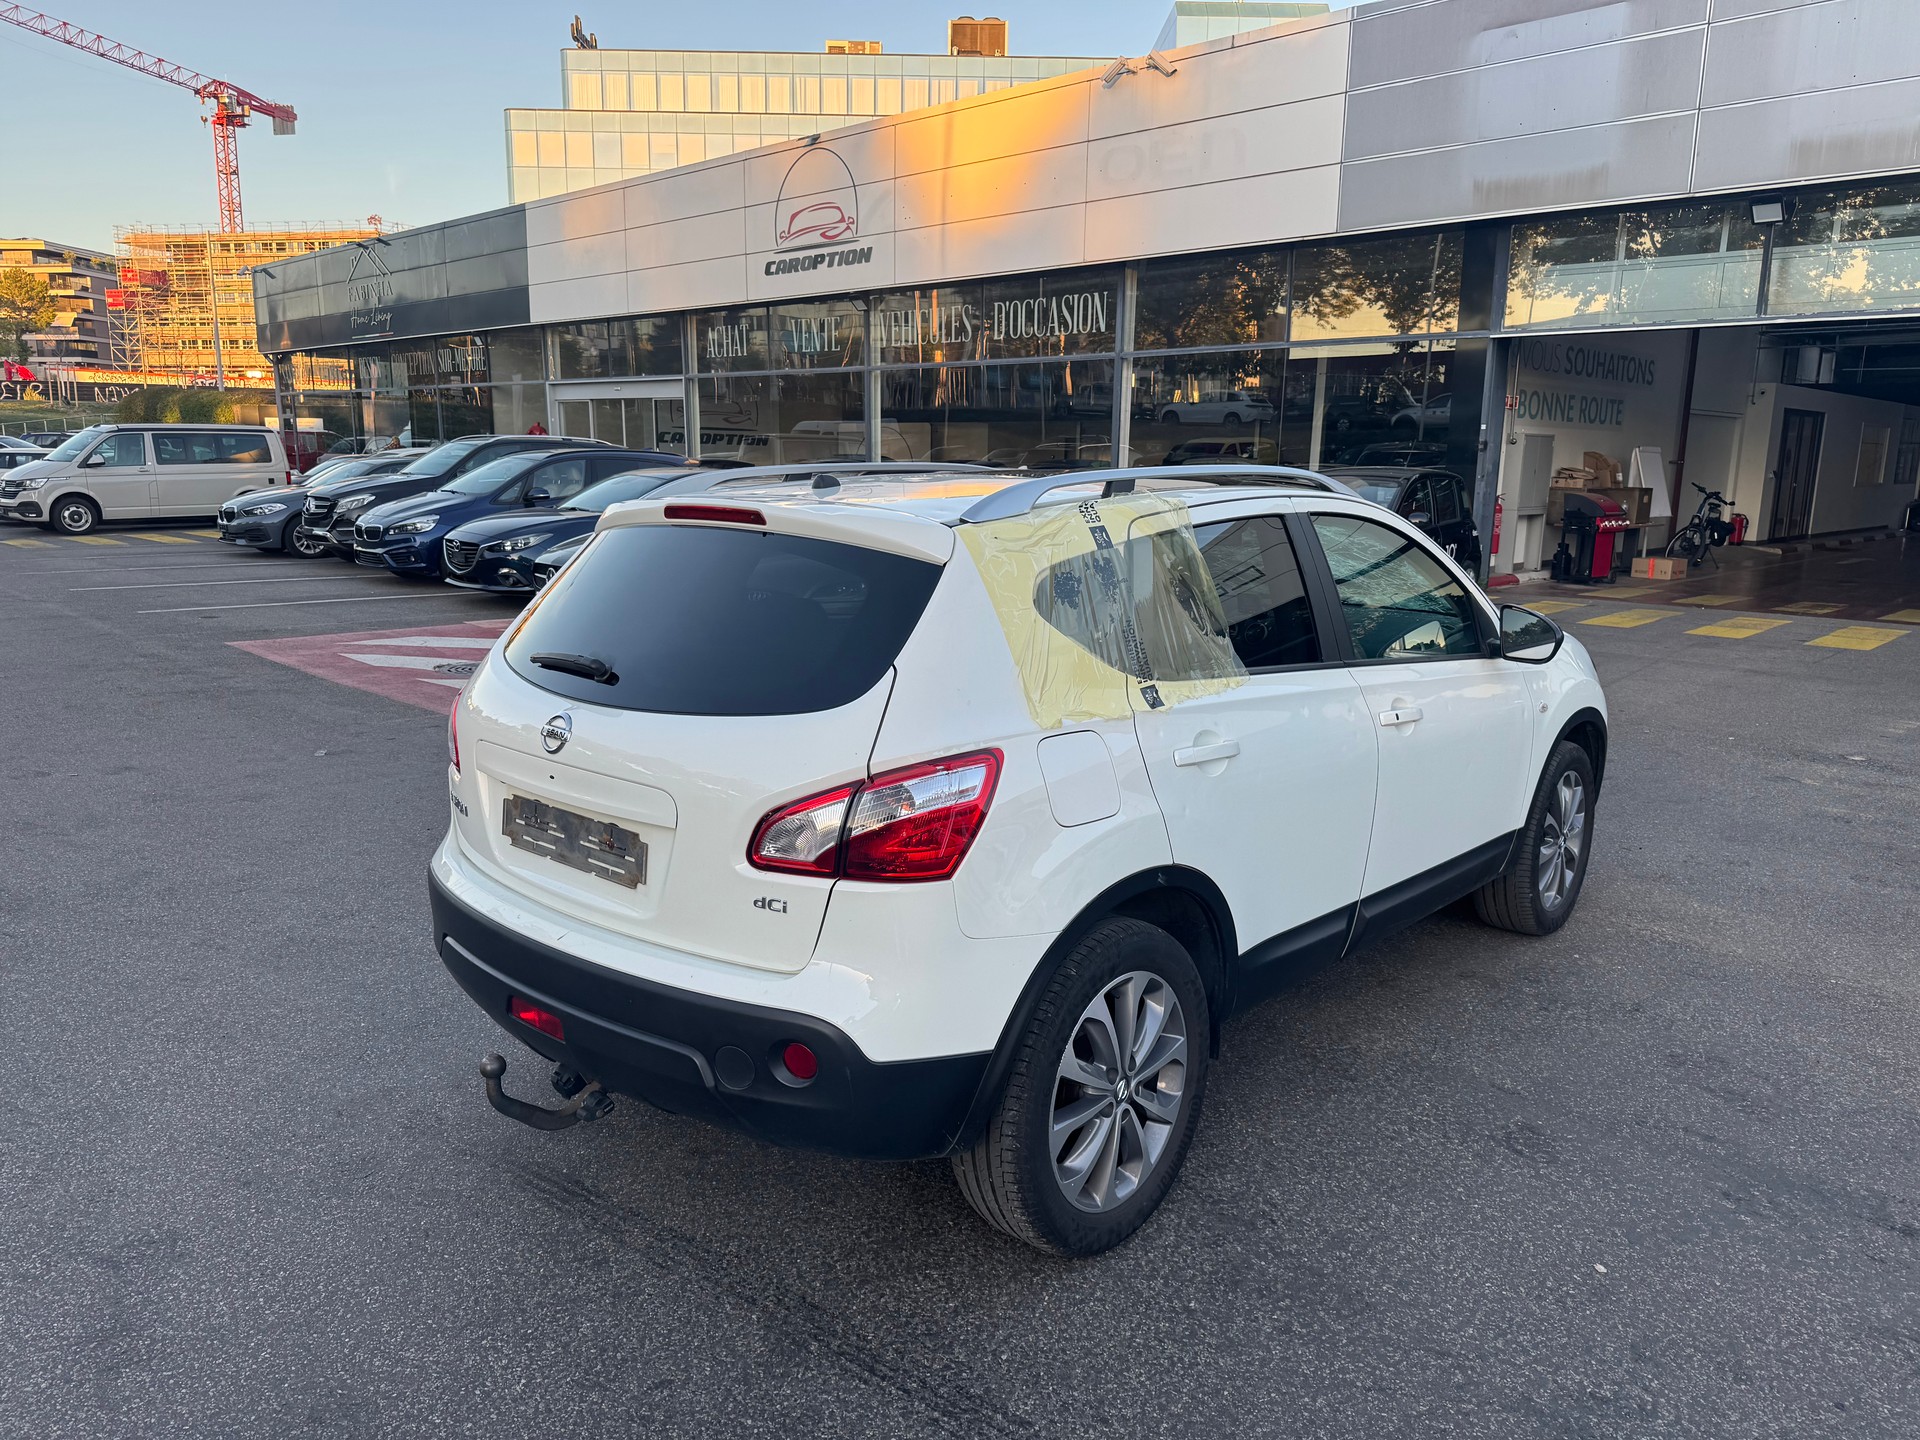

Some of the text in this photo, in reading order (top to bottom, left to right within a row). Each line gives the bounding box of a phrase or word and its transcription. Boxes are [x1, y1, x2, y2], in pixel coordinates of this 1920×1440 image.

[764, 246, 873, 276] CAROPTION
[348, 281, 394, 302] FABINHA
[706, 291, 1108, 358] ACHAT VENTE VEHICULES D'OCCASION
[1521, 340, 1562, 373] VOUS
[1564, 345, 1656, 386] SOUHAITONS
[1517, 388, 1625, 426] BONNE ROUTE
[658, 431, 770, 447] CAOPTION
[753, 896, 787, 914] dCi
